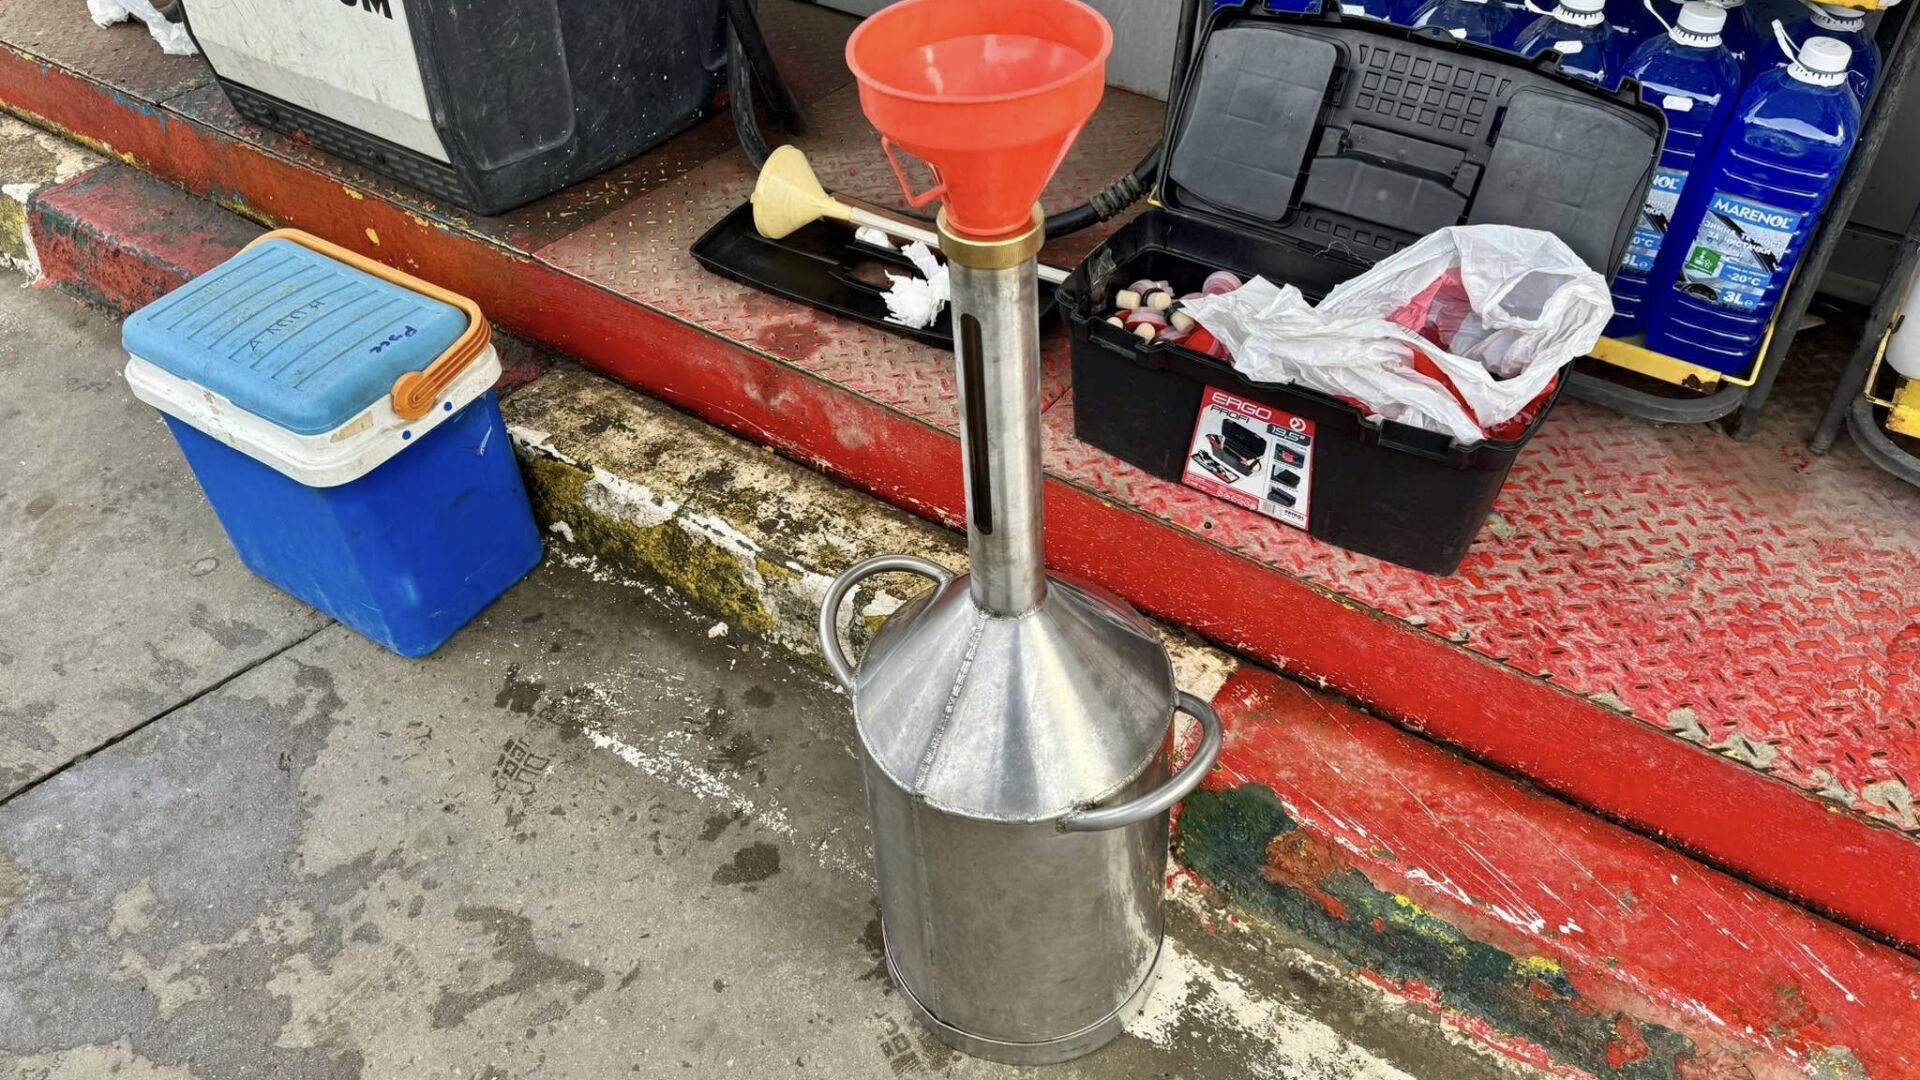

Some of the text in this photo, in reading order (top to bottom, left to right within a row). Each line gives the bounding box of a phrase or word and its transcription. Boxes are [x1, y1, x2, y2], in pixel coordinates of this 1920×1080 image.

[1713, 198, 1791, 230] MARENOL
[1210, 405, 1250, 424] PROFI
[1212, 391, 1272, 420] ERGO
